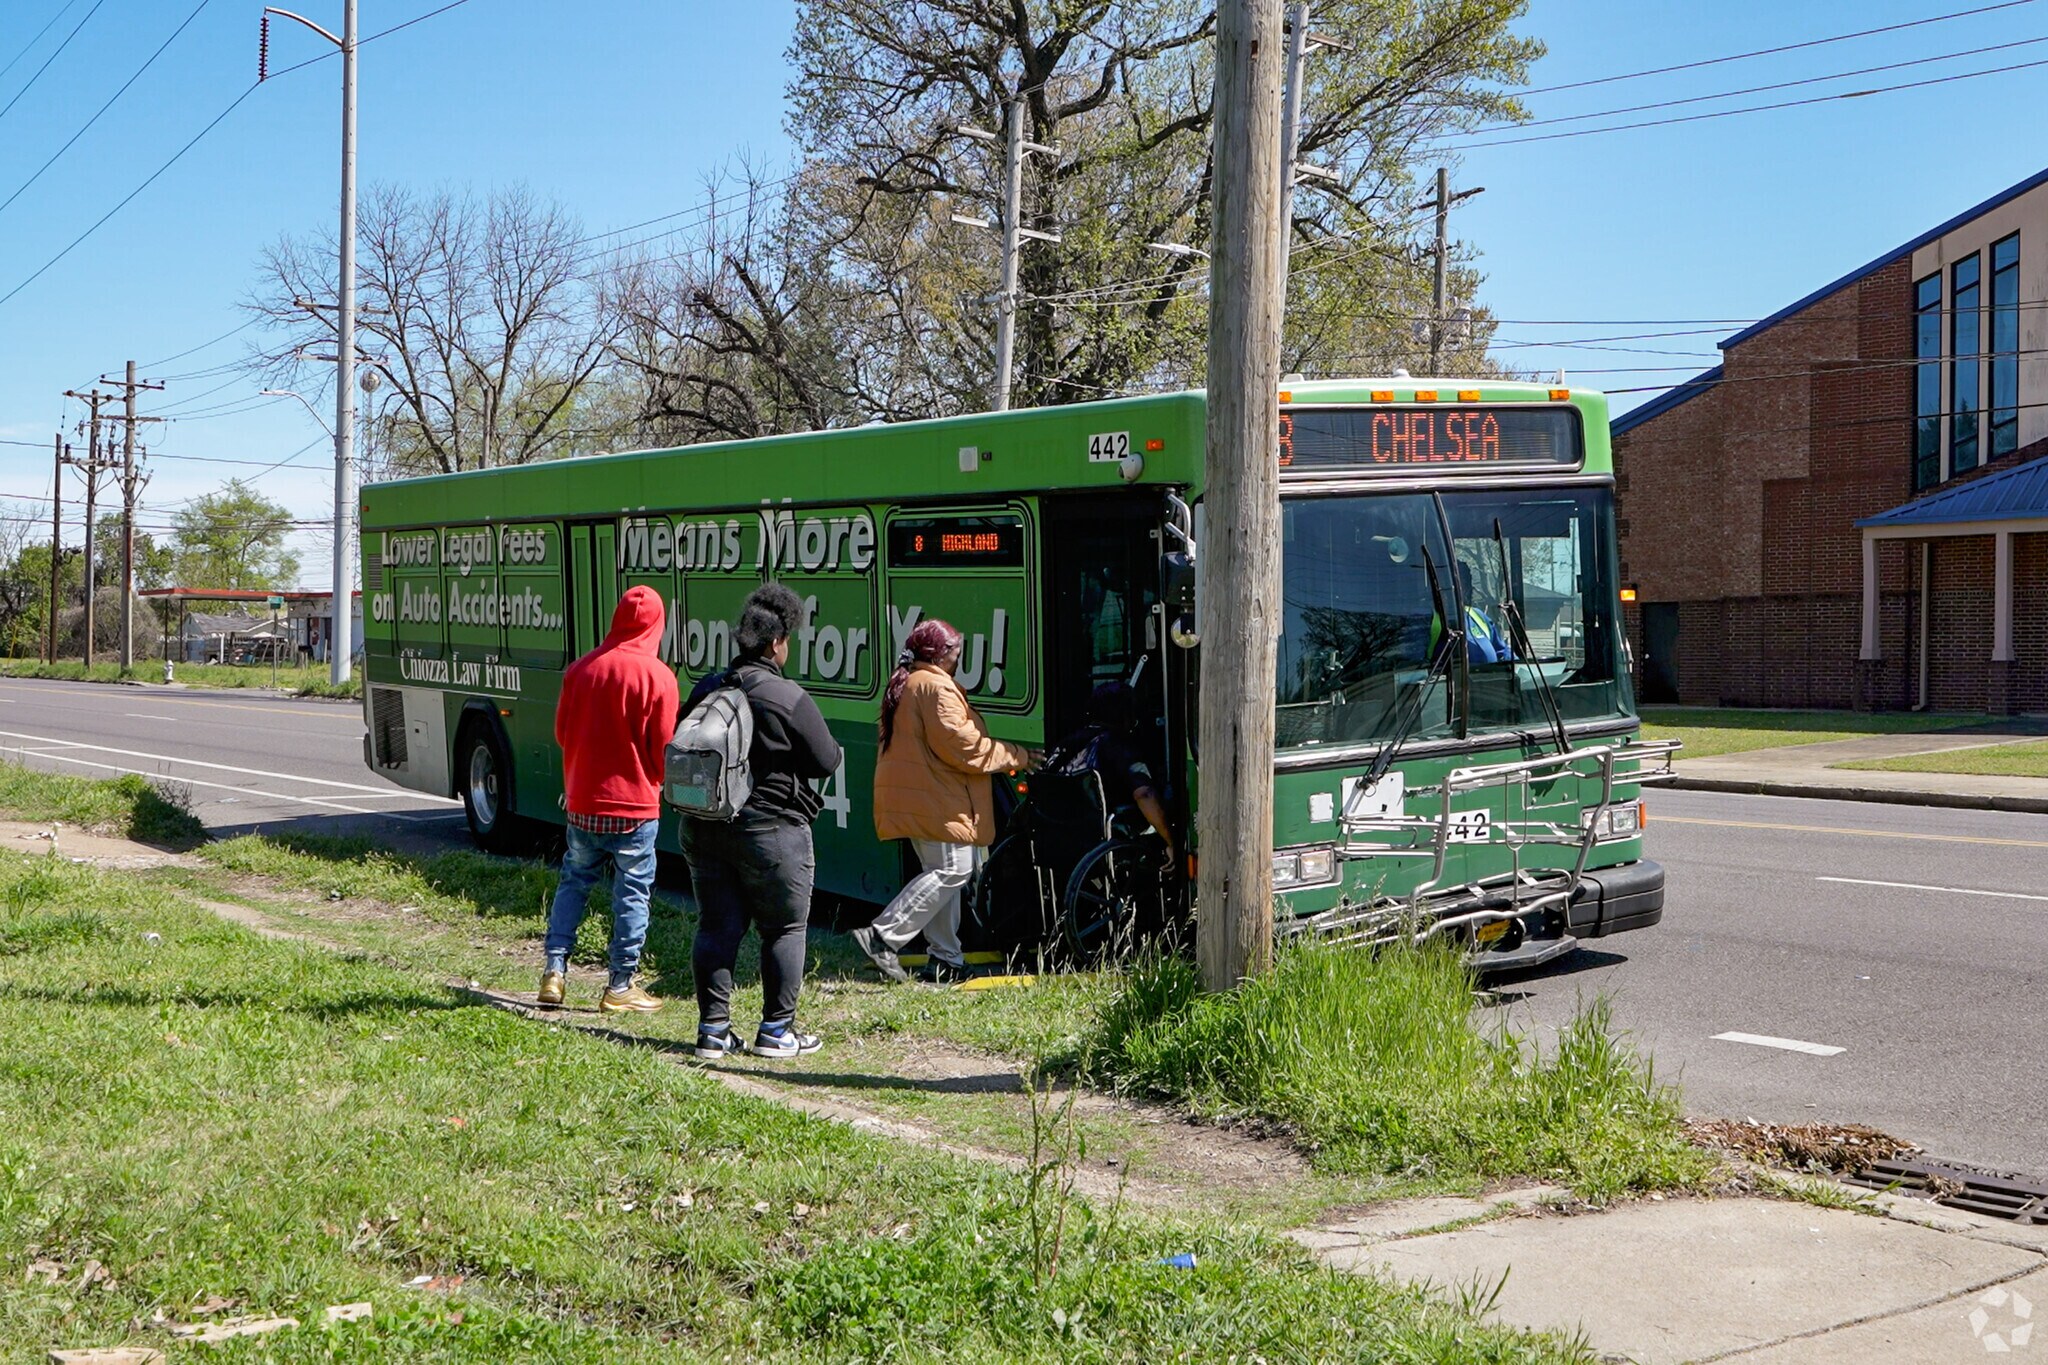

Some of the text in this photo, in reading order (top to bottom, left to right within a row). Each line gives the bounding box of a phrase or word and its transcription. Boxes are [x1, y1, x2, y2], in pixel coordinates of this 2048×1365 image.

[1090, 433, 1128, 460] 442
[1372, 412, 1499, 462] CHELSEA
[382, 516, 546, 575] Lower Legal Fees
[619, 497, 875, 570] Means More
[915, 533, 998, 552] 8 HIGHLAND
[372, 593, 394, 621] on
[400, 581, 441, 623] Auto
[797, 595, 867, 679] for
[886, 604, 1006, 694] Yu!
[400, 648, 522, 692] Chiozza Law Firm
[1446, 812, 1487, 841] 42
